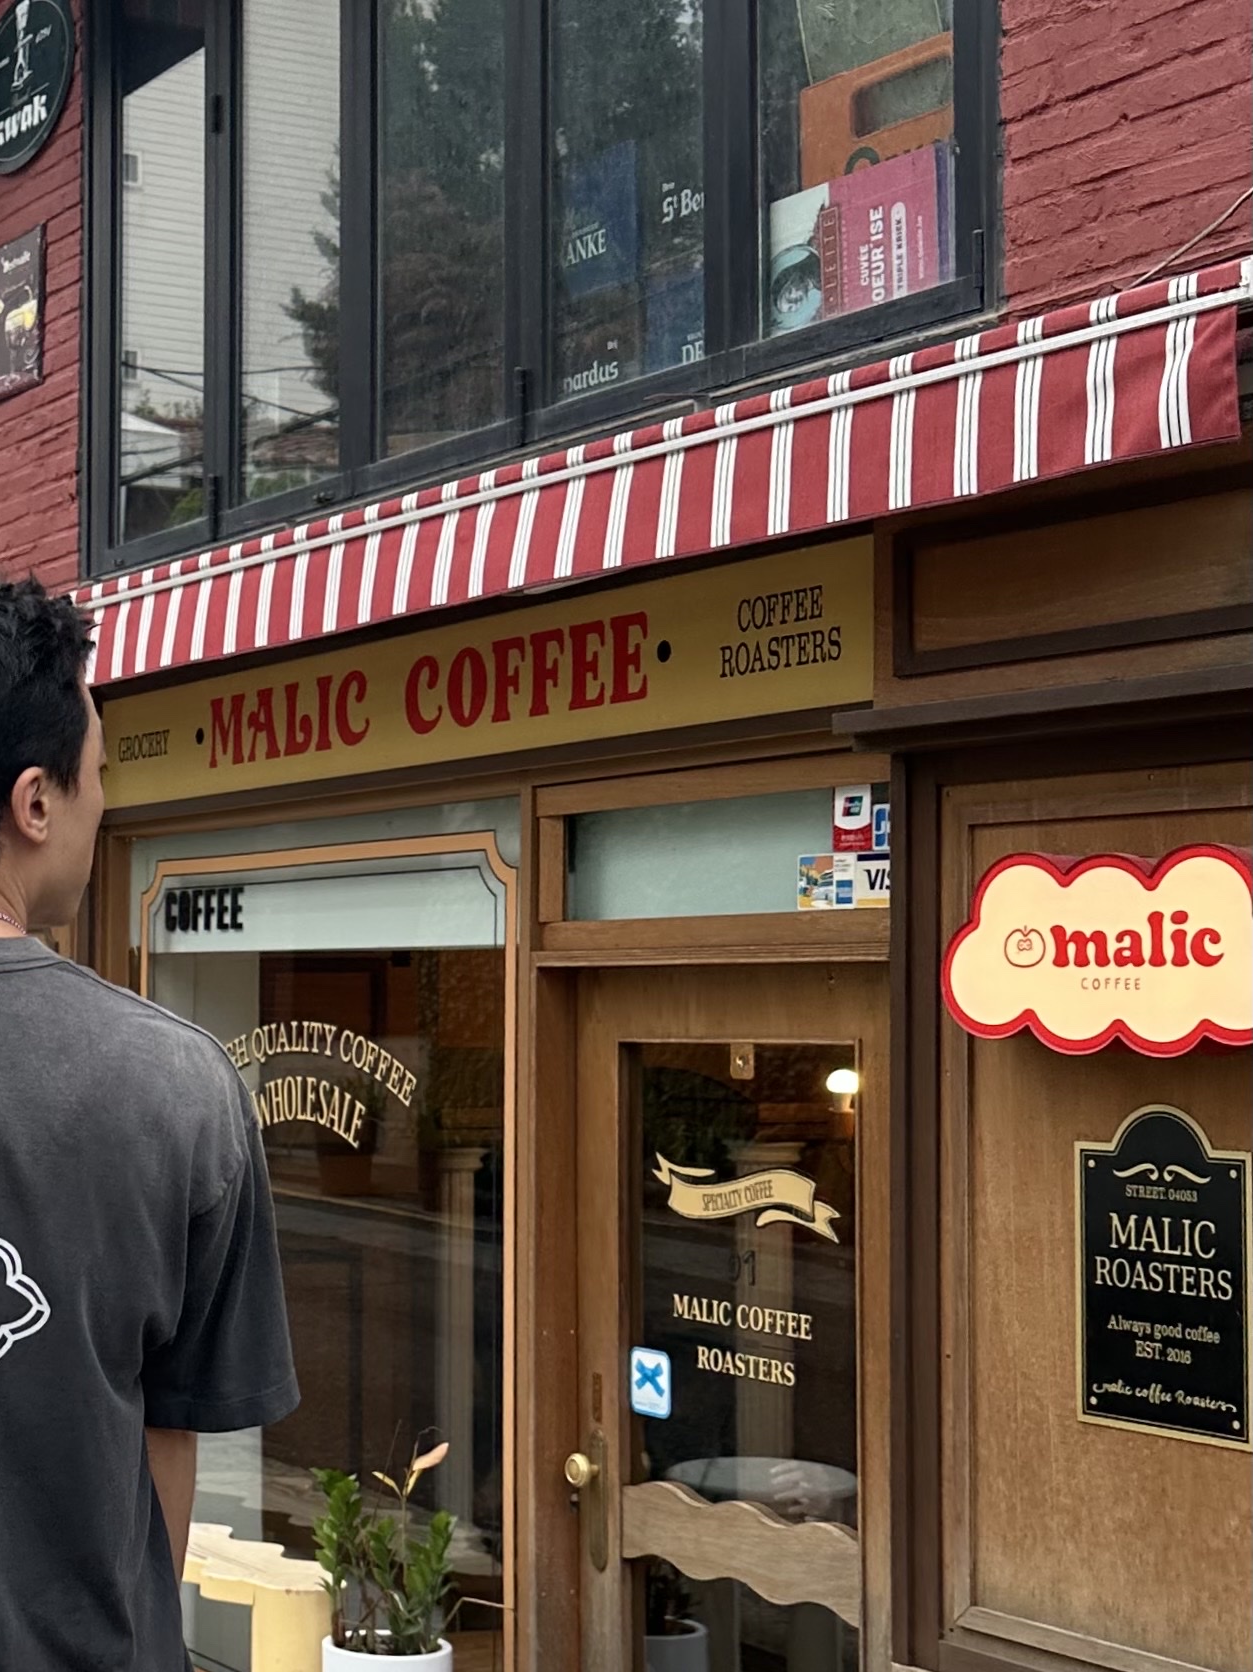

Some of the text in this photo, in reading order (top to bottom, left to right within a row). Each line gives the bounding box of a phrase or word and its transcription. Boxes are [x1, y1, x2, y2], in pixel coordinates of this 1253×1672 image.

[858, 244, 870, 286] CUVÉE
[869, 205, 886, 305] OEUR'ISE
[737, 585, 823, 632] COFFEE
[720, 626, 842, 678] ROASTERS
[118, 611, 649, 769] GROCERY MALIC COFFEE
[165, 887, 245, 932] COFFEE
[1050, 910, 1225, 968] malic
[1081, 977, 1141, 991] COFFEE
[251, 1021, 337, 1063] QUALITY
[339, 1030, 417, 1107] COFFEE
[251, 1076, 366, 1149] WHOLESALE
[702, 1180, 775, 1212] SPECIALTY COFFEE
[1109, 1212, 1216, 1260] MALIC
[1095, 1256, 1234, 1301] ROASTERS
[673, 1293, 812, 1341] MALIC COFFEE
[1107, 1314, 1221, 1344] Always good coffee
[697, 1345, 795, 1387] ROASTERS
[1135, 1383, 1173, 1404] coffee
[1174, 1390, 1238, 1413] Roasters
